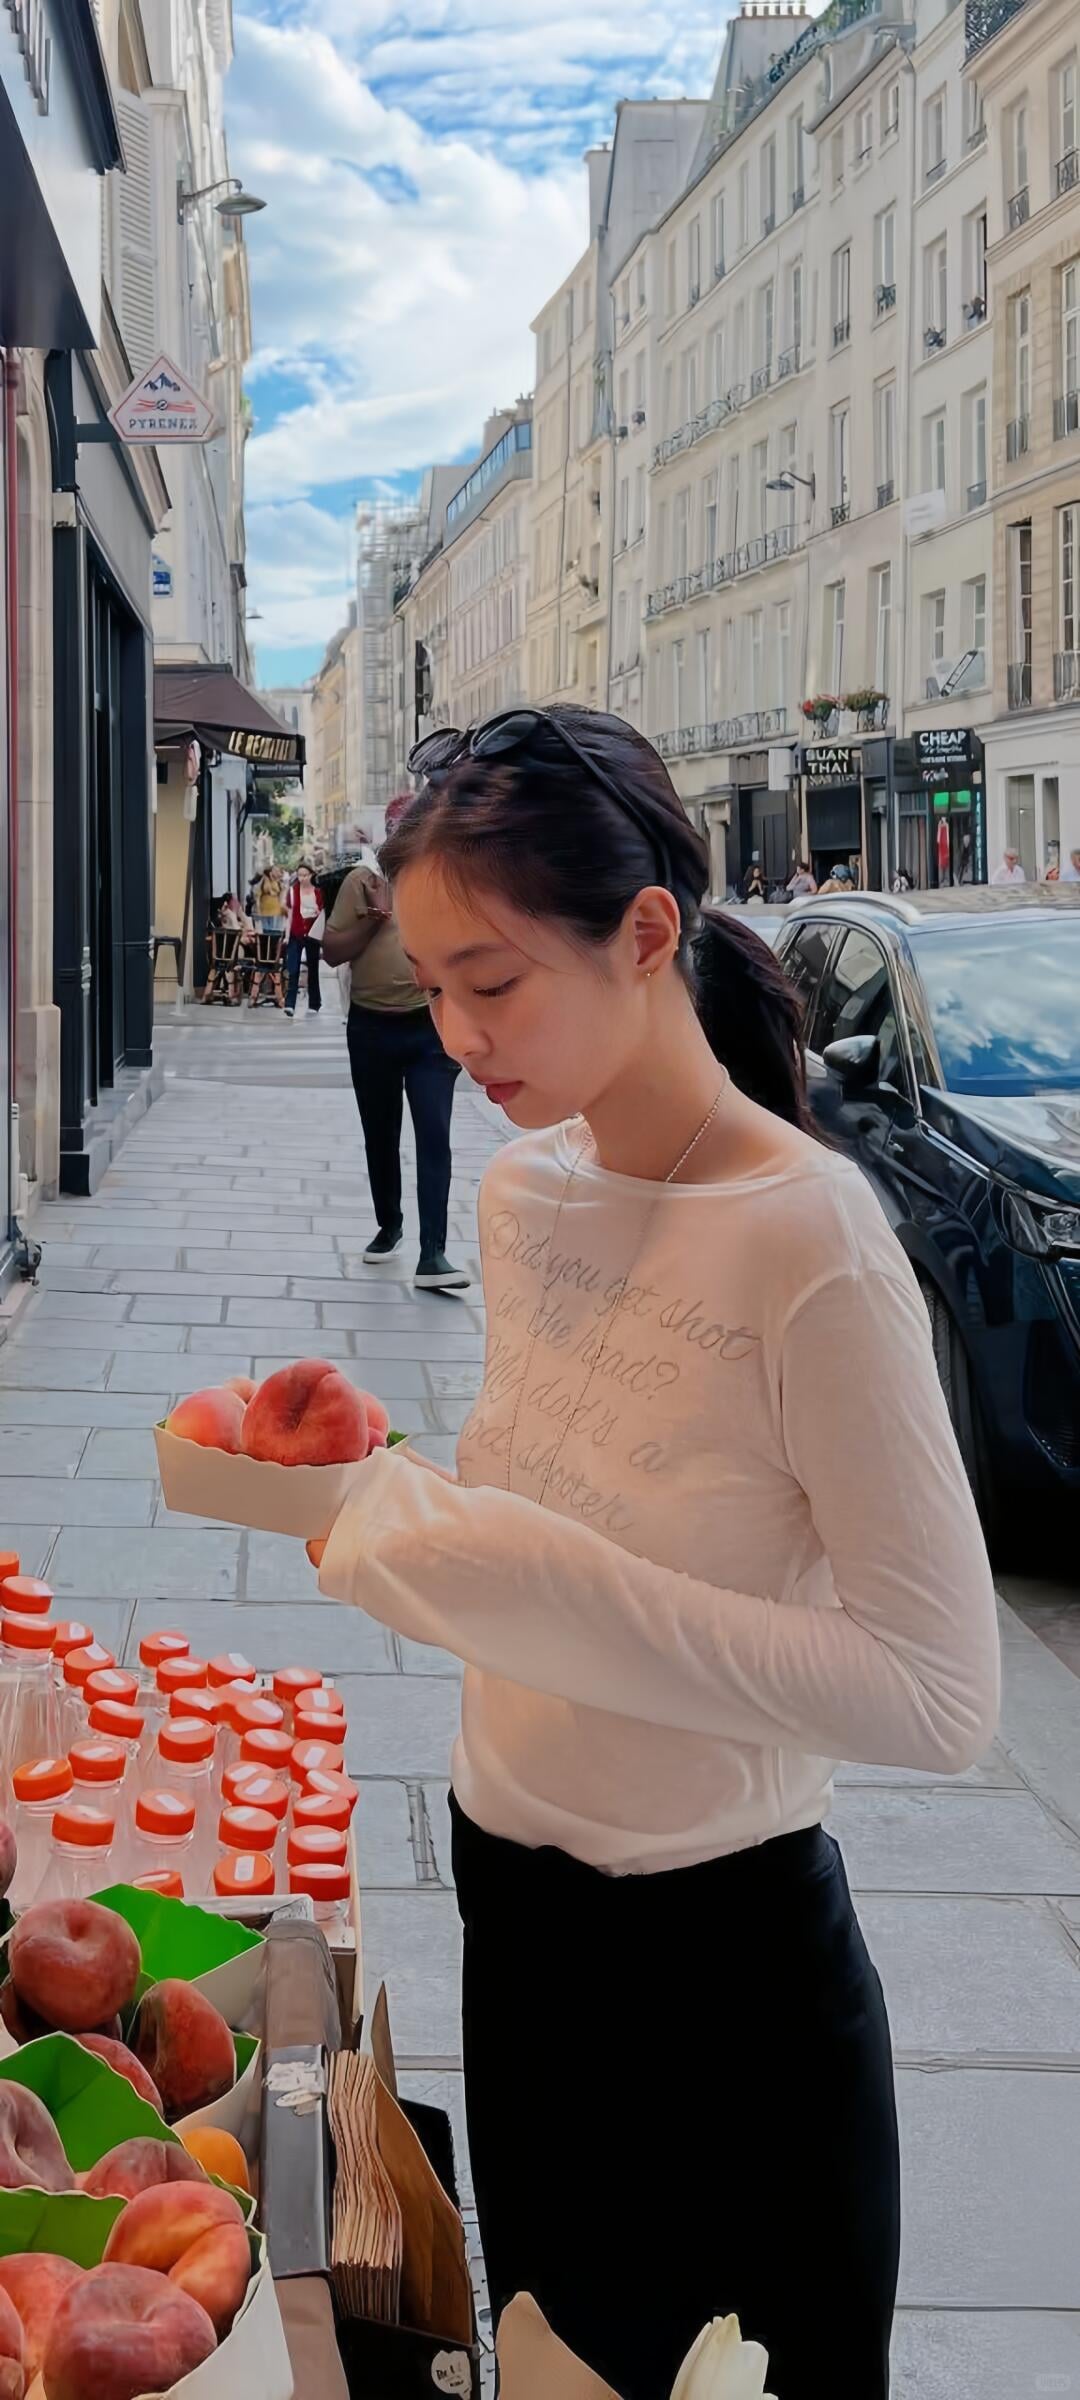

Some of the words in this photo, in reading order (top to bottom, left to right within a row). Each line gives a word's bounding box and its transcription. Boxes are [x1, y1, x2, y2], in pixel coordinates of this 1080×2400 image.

[919, 730, 967, 747] CHEAP
[807, 761, 848, 774] THAI
[487, 1210, 550, 1270] Did
[542, 1252, 601, 1292] you
[594, 1275, 661, 1317] get
[659, 1298, 762, 1361] shot
[495, 1287, 526, 1321] in
[526, 1302, 571, 1350] the
[570, 1318, 680, 1401] head?
[629, 1441, 668, 1474] a
